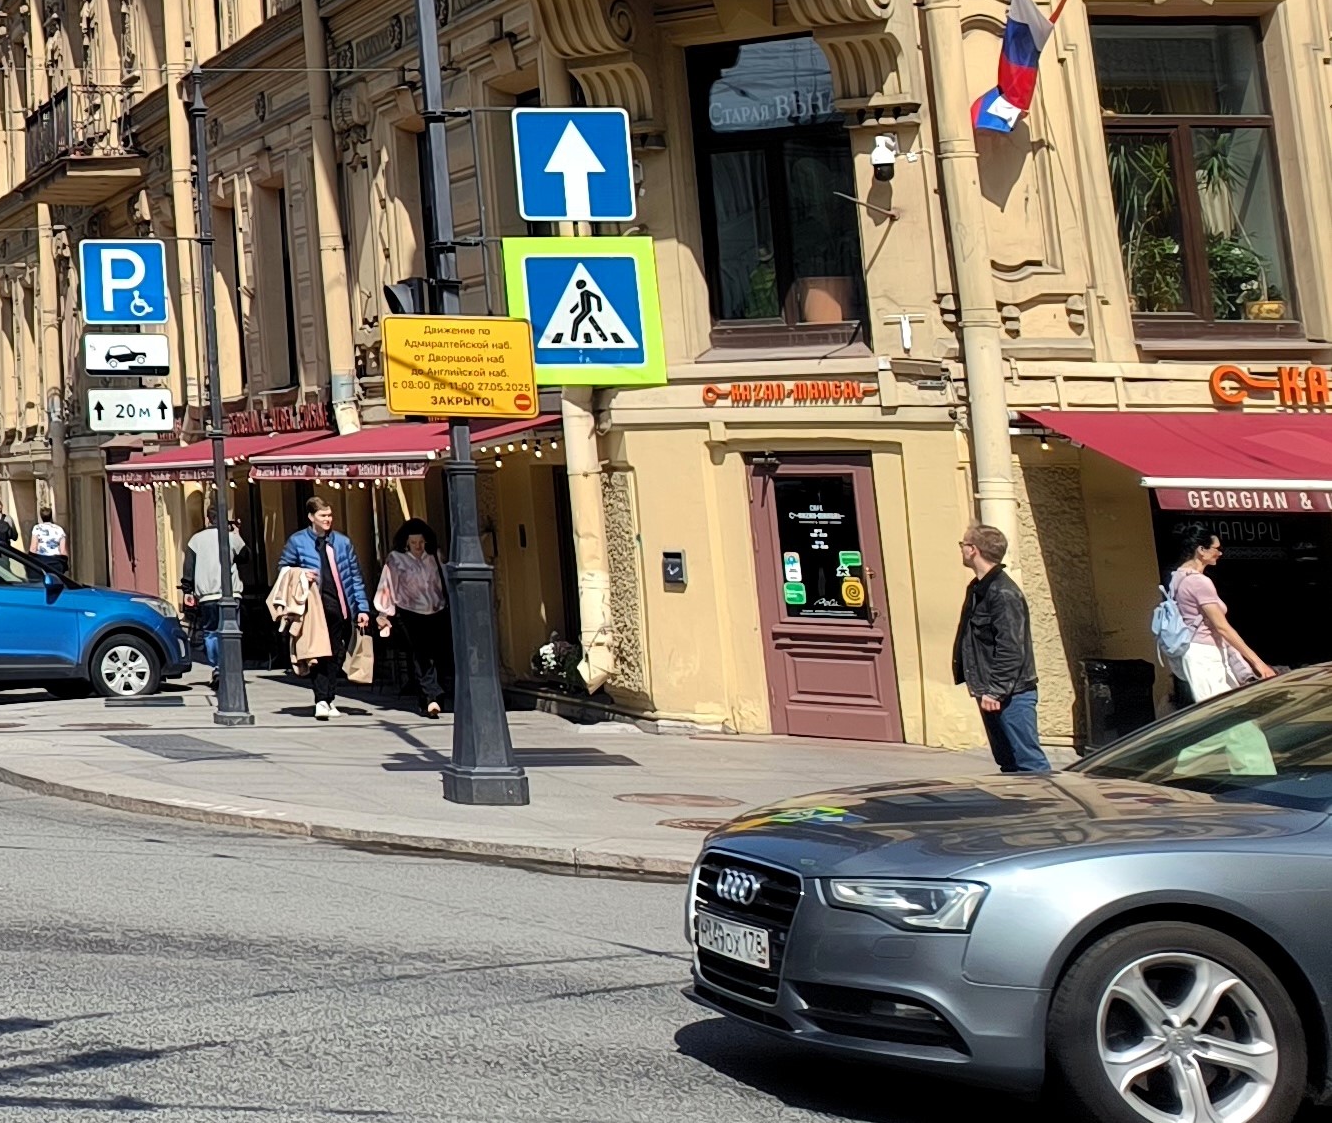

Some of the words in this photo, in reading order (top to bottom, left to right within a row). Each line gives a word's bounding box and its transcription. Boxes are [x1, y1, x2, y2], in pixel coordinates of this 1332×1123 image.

[423, 325, 475, 336] Движение
[478, 327, 491, 336] по
[404, 339, 489, 350] Адмиралтейской
[414, 354, 425, 363] от
[428, 353, 484, 365] Дворцовой
[411, 368, 424, 377] до
[427, 367, 486, 378] Английской
[433, 381, 446, 391] до
[430, 395, 495, 407] ЗАКРЫТО!
[1187, 490, 1289, 510] GEORGIAN
[1299, 492, 1314, 510] &
